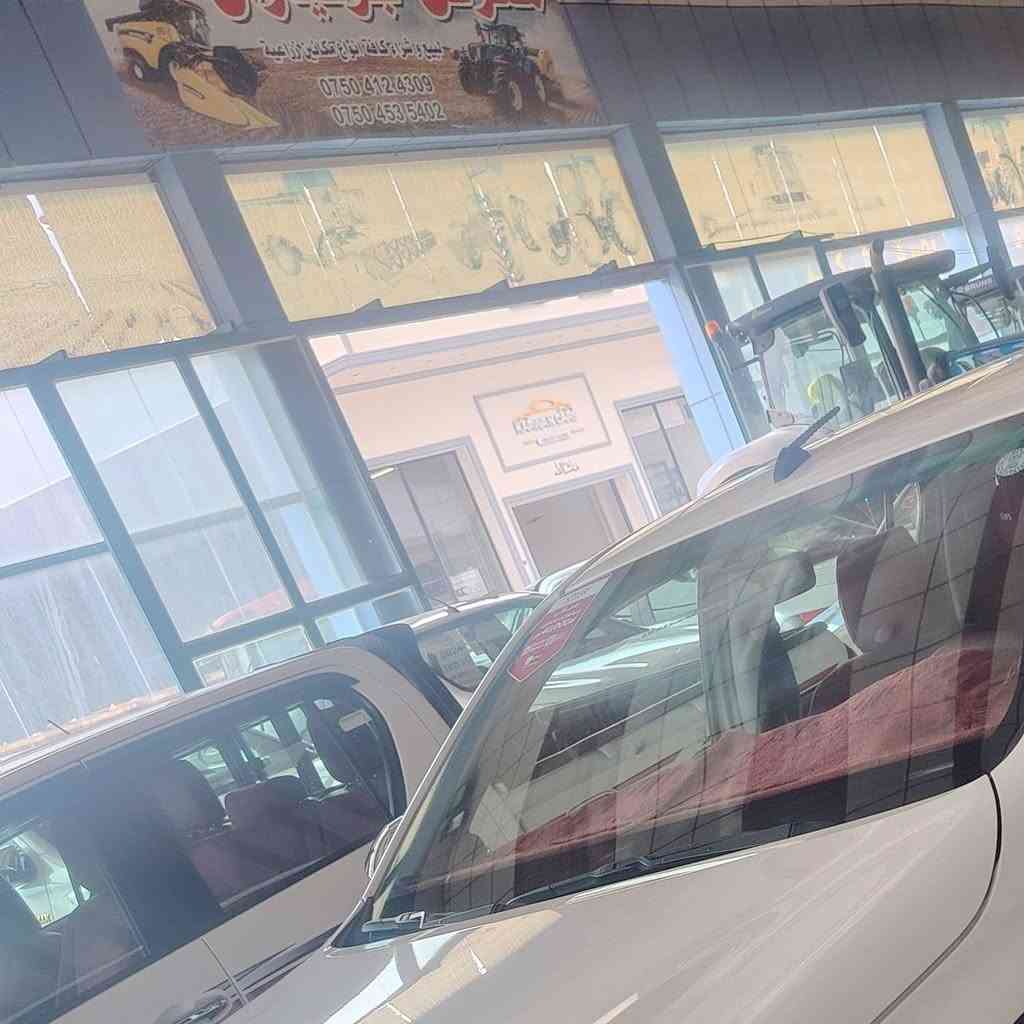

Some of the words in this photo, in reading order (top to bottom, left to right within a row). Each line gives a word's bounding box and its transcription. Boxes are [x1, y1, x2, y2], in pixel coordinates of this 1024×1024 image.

[319, 78, 361, 97] 0750
[364, 76, 394, 95] 412
[397, 74, 433, 94] 4309
[332, 105, 373, 124] 0750
[376, 103, 404, 122] 453
[406, 102, 445, 121] 5402
